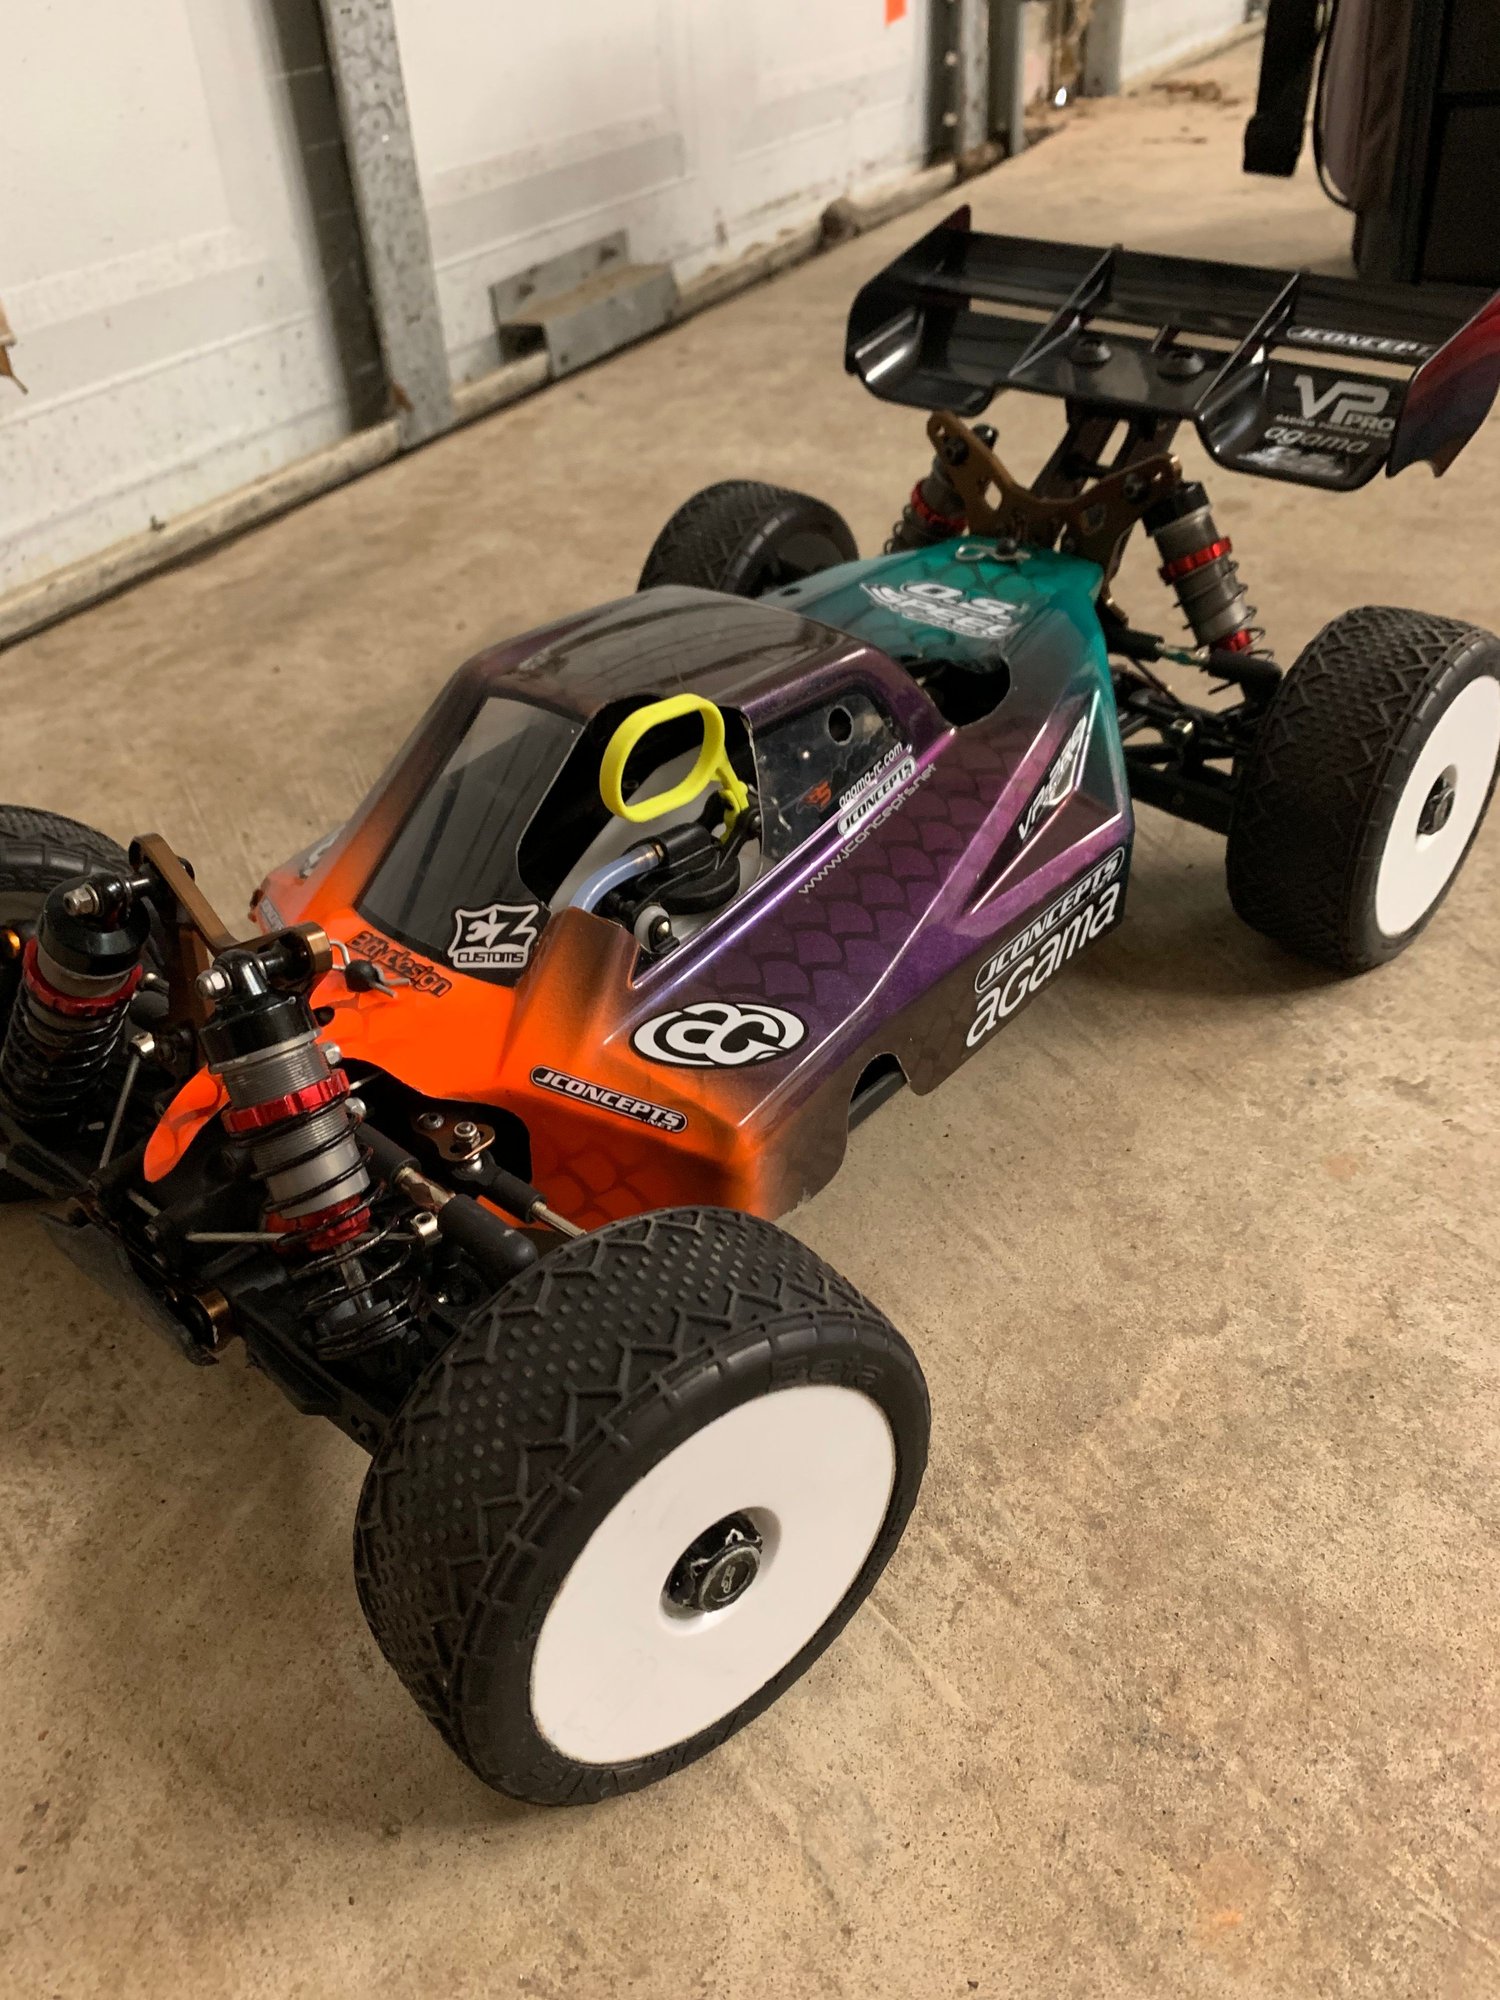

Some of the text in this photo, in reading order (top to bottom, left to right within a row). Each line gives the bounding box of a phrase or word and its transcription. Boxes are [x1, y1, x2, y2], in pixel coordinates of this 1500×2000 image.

[1294, 374, 1390, 424] VP
[1345, 412, 1395, 431] PRO
[1264, 426, 1369, 453] agama
[843, 760, 914, 830] JCONCEPTS
[979, 851, 1120, 988] JCONCEPTS
[457, 951, 524, 963] CUSTOMS
[535, 1070, 683, 1127] JCONCEPTS
